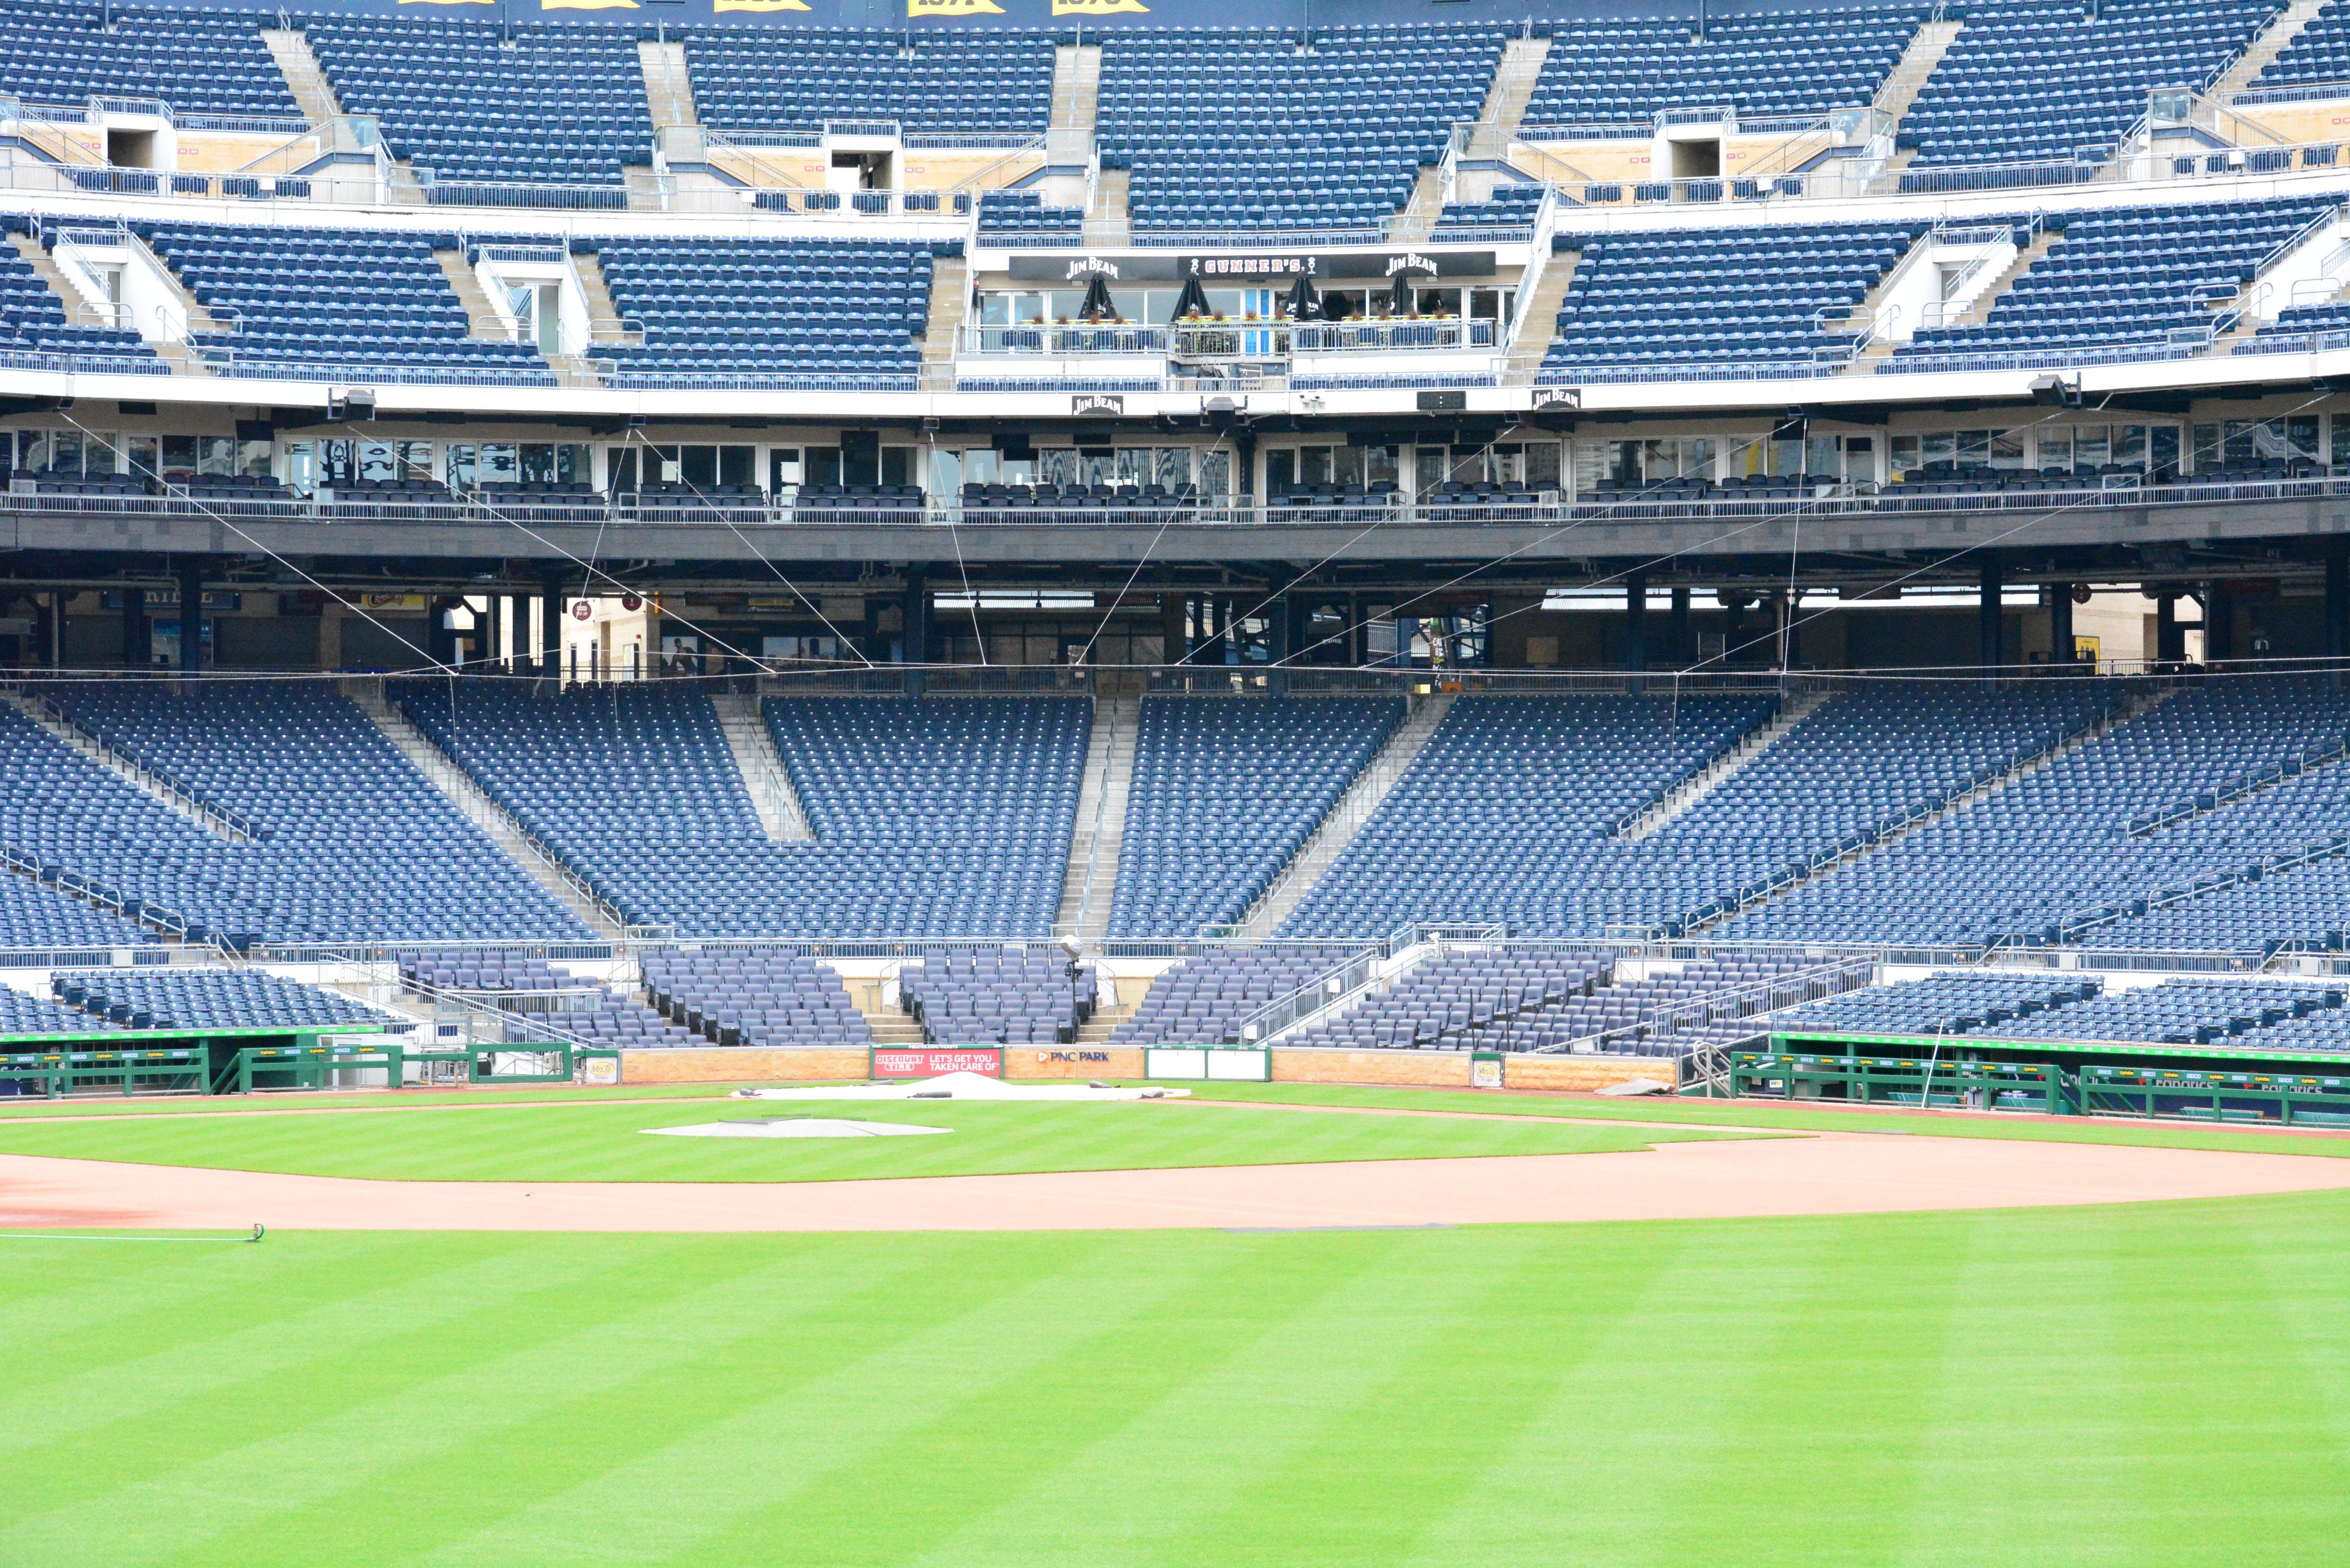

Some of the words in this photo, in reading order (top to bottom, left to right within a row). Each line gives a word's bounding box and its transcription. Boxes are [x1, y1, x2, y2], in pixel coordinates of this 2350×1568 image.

[1066, 260, 1087, 280] JIM
[1088, 257, 1119, 280] BEAM
[1205, 259, 1300, 273] GUNNER'S
[1386, 257, 1407, 276] JIM
[1407, 253, 1438, 276] BEAM
[1074, 398, 1092, 415] JIM
[1093, 395, 1121, 414] BEAM
[1533, 391, 1551, 410] JIM
[1552, 389, 1578, 409] BEAM
[876, 1055, 924, 1064] DISCOUNT
[930, 1054, 952, 1063] LET'S
[954, 1054, 972, 1063] GET
[973, 1054, 992, 1063] YOU
[1051, 1052, 1076, 1062] PNC
[1079, 1052, 1110, 1062] PARK
[929, 1063, 959, 1071] TAKEN
[960, 1063, 983, 1071] CARE
